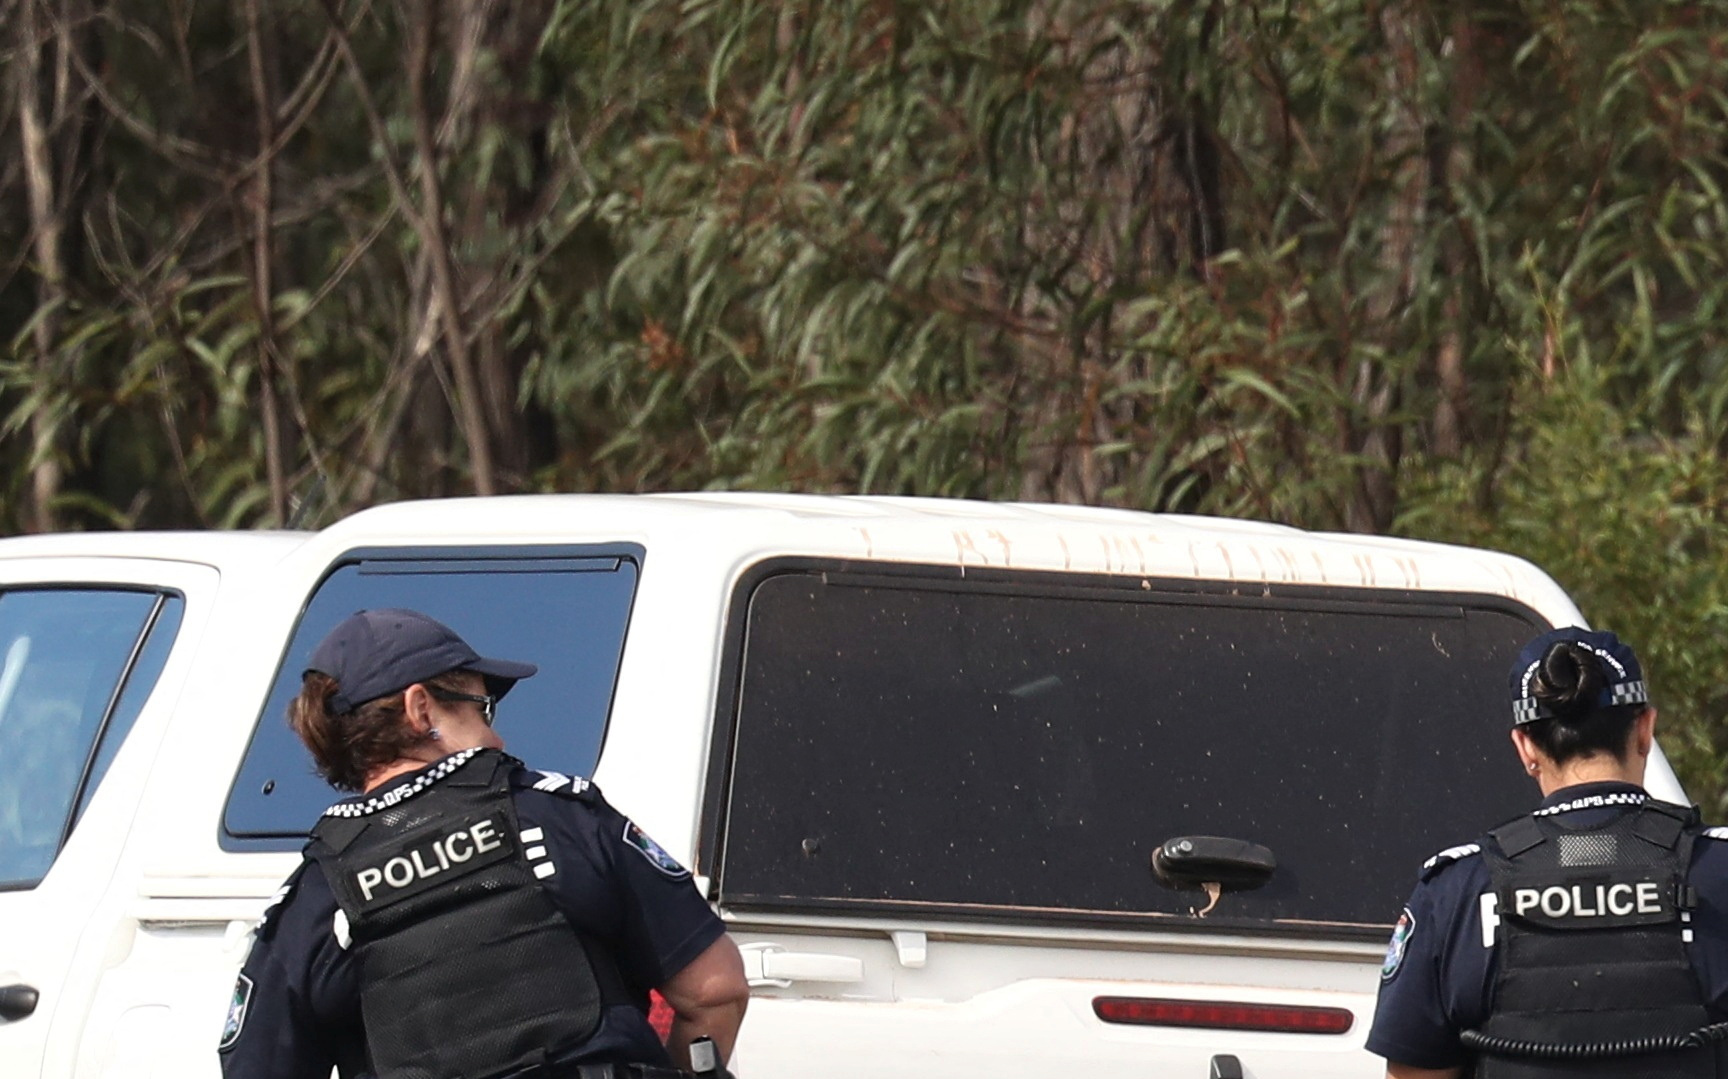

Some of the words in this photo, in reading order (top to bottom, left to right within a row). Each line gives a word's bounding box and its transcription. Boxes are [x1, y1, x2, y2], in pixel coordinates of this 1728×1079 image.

[383, 783, 414, 806] QPS
[356, 819, 501, 901] POLICE
[1515, 882, 1662, 918] POLICE
